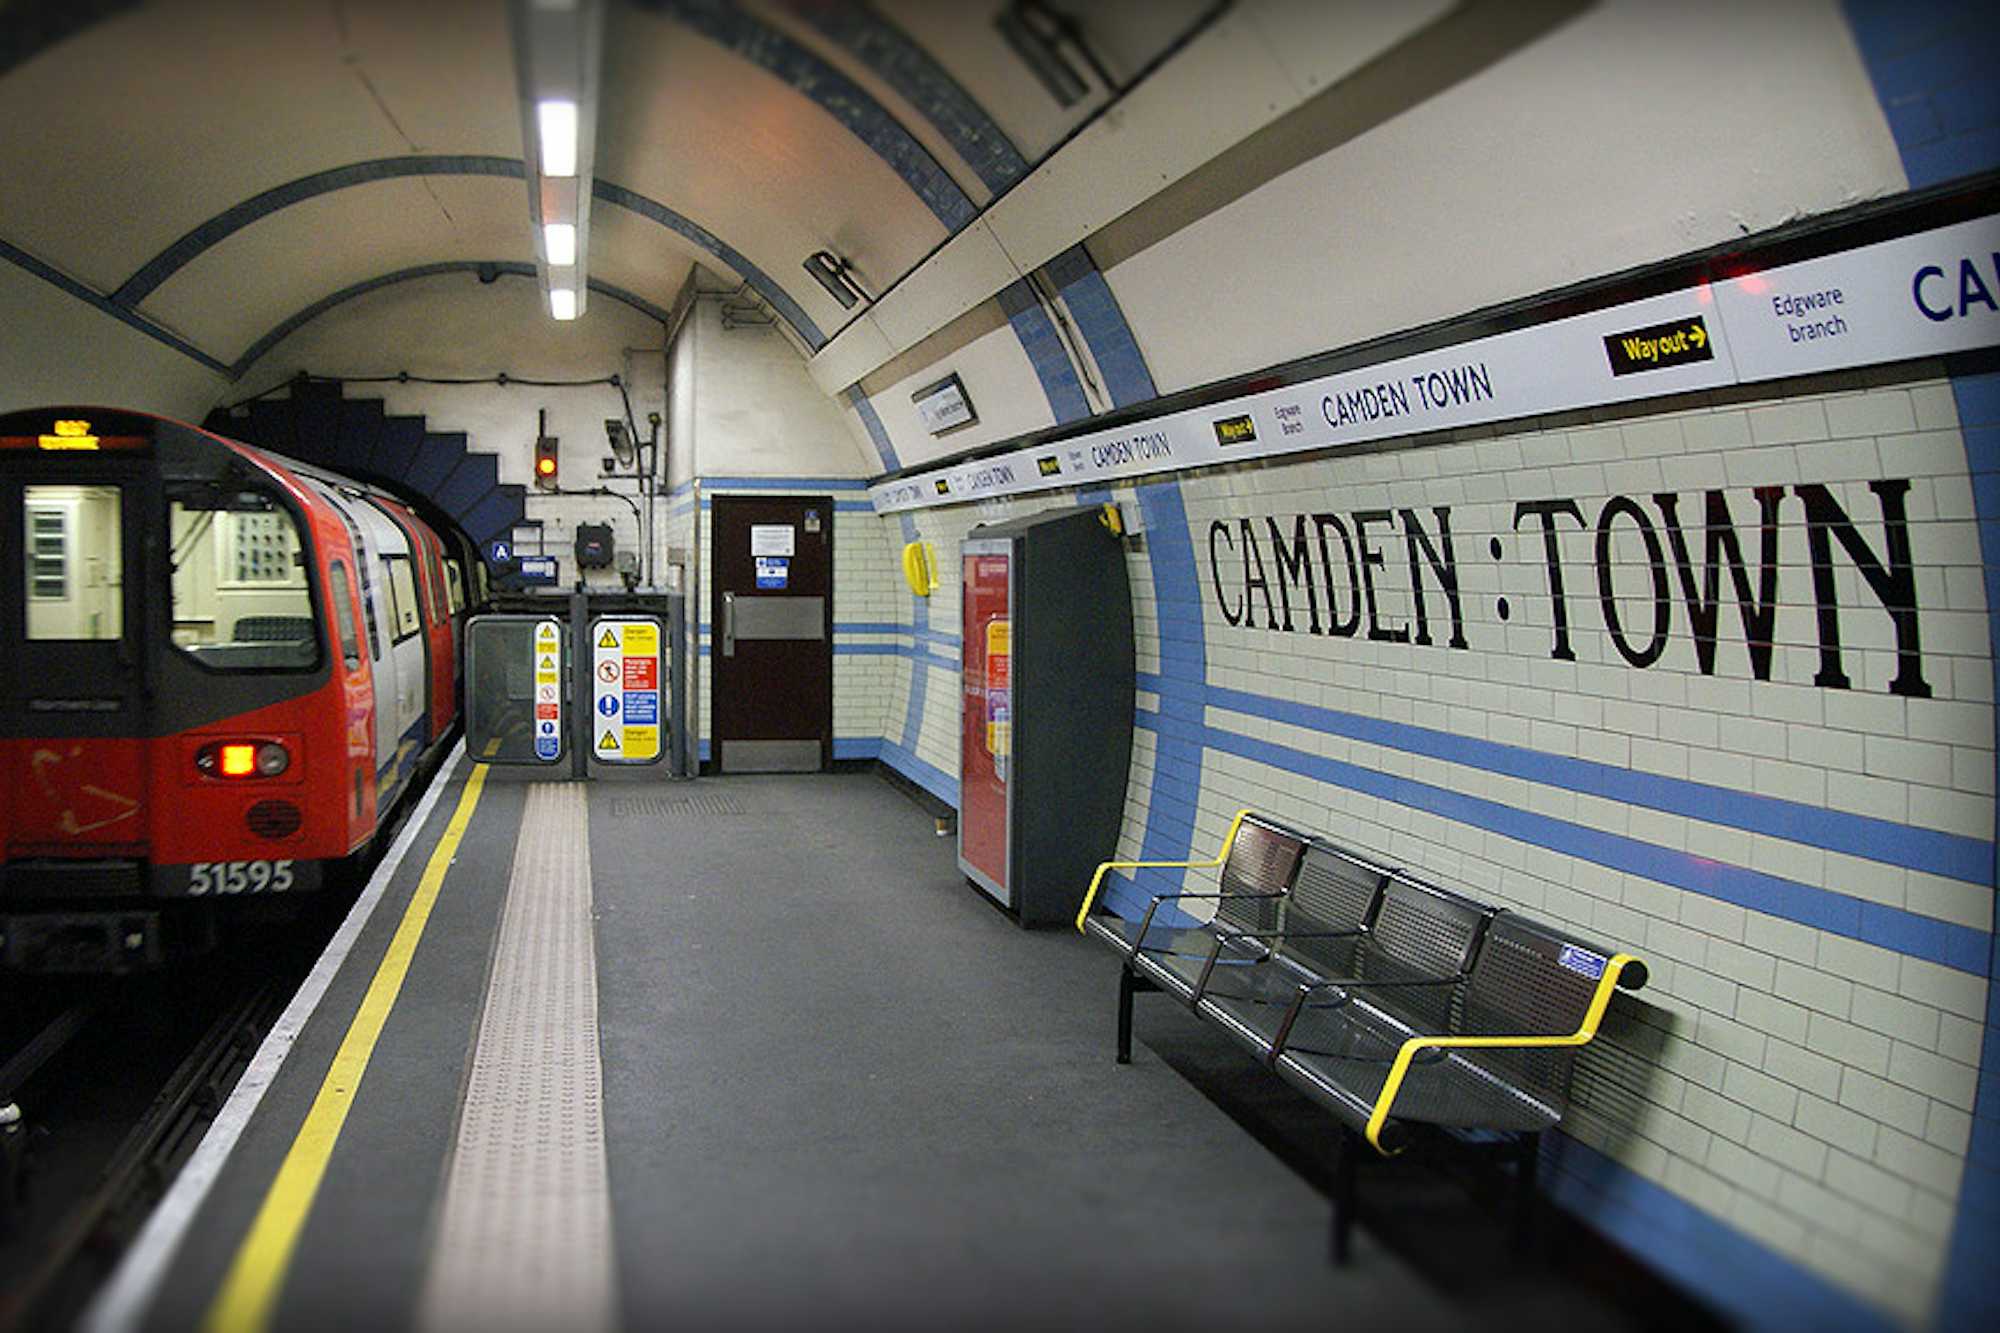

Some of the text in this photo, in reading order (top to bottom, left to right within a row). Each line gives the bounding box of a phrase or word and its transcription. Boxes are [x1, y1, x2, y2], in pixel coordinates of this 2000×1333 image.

[1772, 288, 1844, 318] Edgware
[1913, 250, 2000, 321] CA
[1621, 329, 1690, 362] Way out
[1788, 314, 1848, 344] branch
[1322, 363, 1493, 428] CAMDEN TOWN
[1210, 507, 1469, 650] CAMDEN
[1513, 480, 1933, 698] TOWN
[187, 859, 294, 895] 51595
